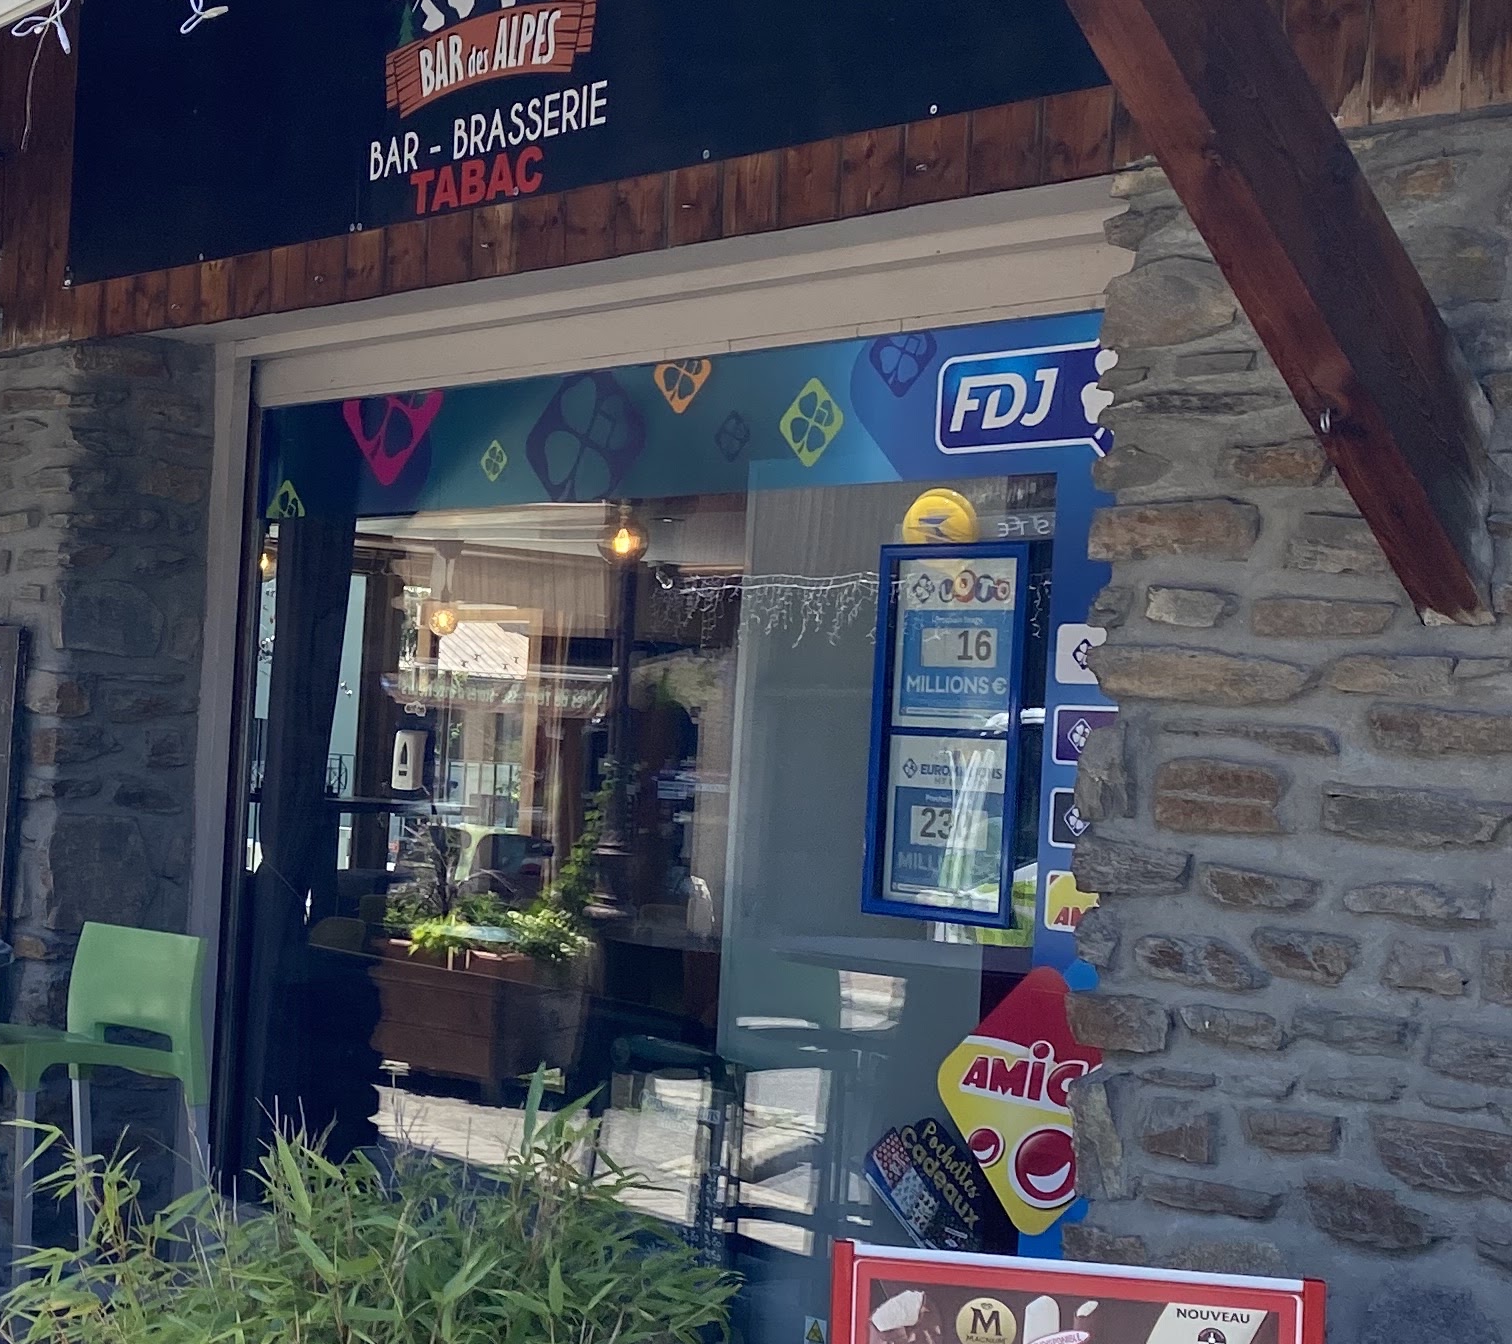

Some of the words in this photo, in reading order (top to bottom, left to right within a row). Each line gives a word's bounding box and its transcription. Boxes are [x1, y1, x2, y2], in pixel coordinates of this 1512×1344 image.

[419, 34, 462, 97] BAR
[467, 45, 489, 77] des
[493, 9, 562, 73] ALPES
[370, 131, 418, 181] BAR
[452, 80, 608, 160] BRASSERIE
[410, 146, 543, 214] TABAC
[949, 367, 1060, 434] FDJ
[939, 569, 1011, 603] LOTO
[957, 630, 992, 661] 16
[906, 675, 988, 694] MILLIONS
[991, 676, 1008, 695] €
[900, 1125, 981, 1230] Cadeaux
[921, 1120, 981, 1199] Pochettes
[1176, 1307, 1251, 1324] NOUVEAU
